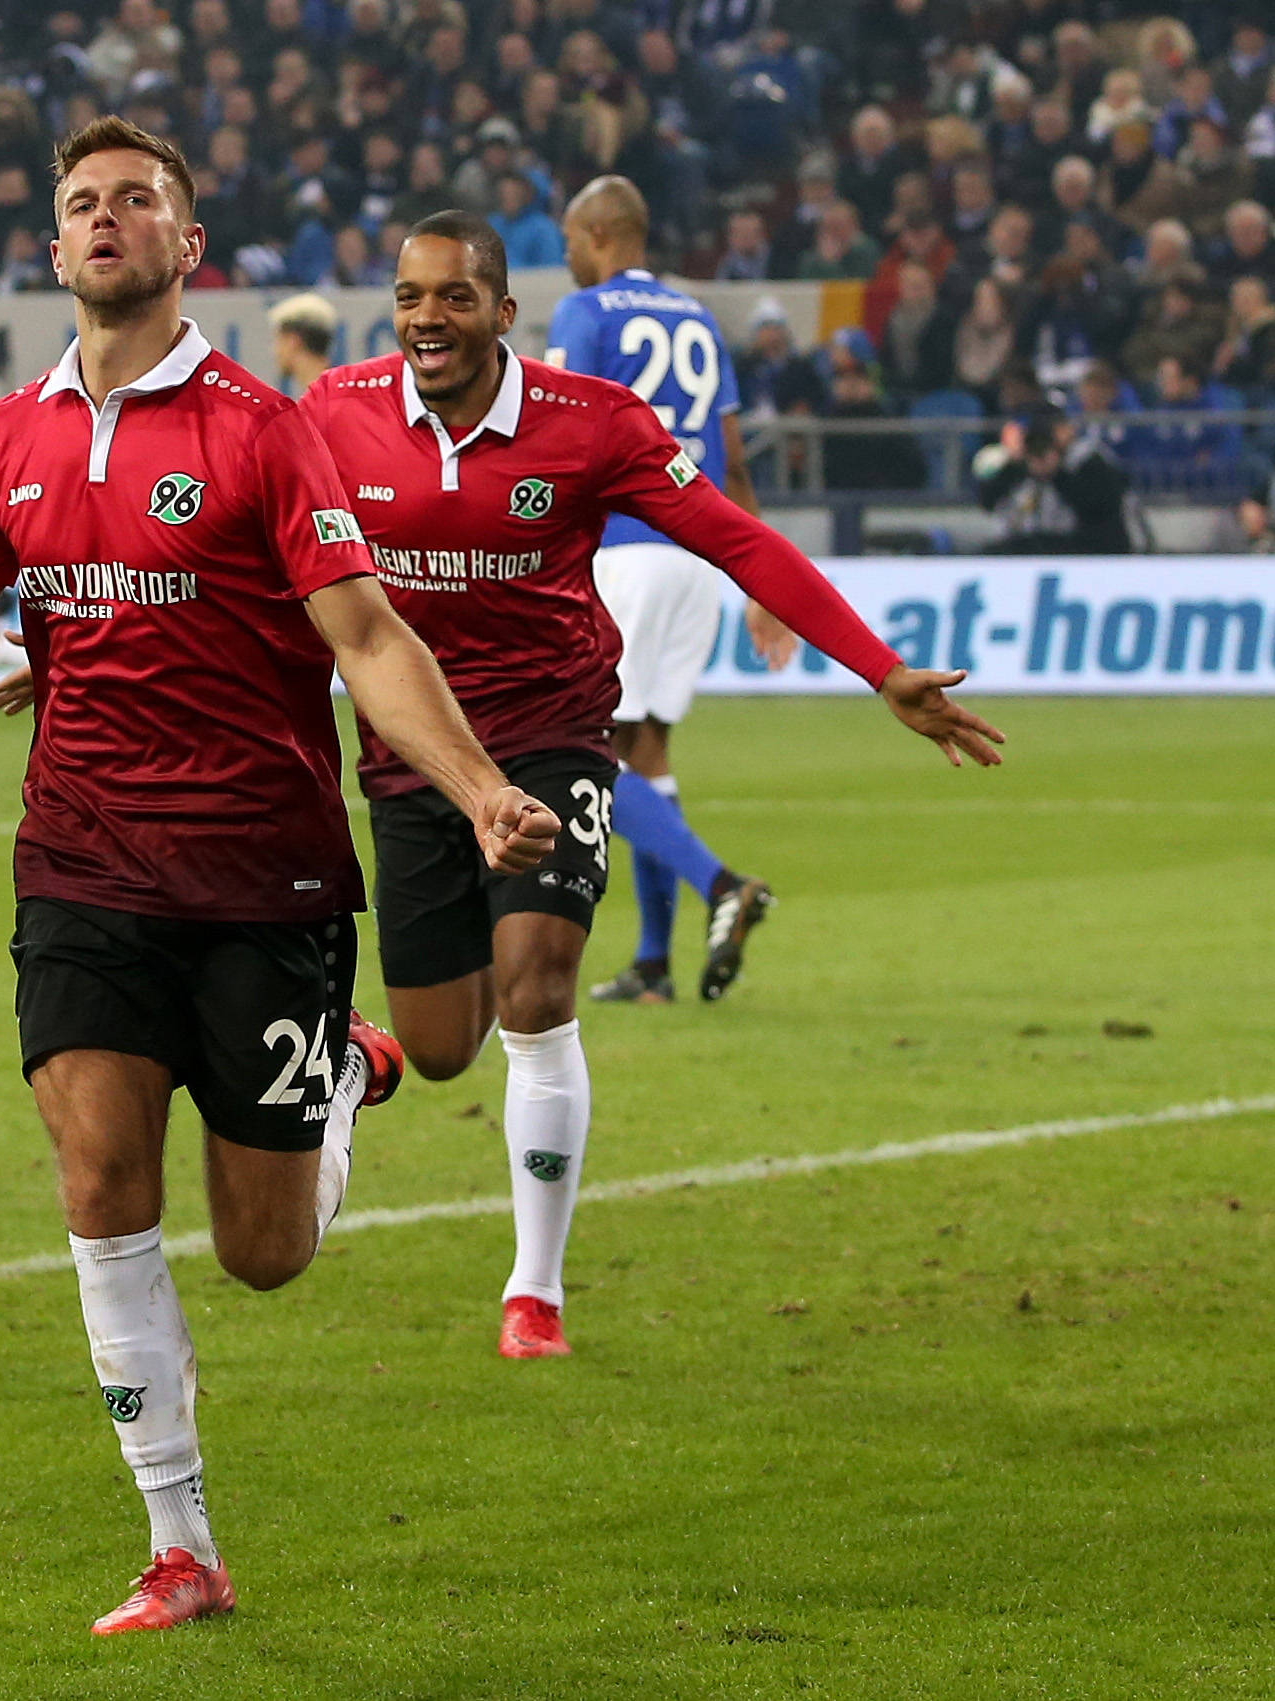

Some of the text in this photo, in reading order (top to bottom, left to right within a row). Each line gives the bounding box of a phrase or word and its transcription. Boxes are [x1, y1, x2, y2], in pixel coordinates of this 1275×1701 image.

[620, 316, 719, 430] 29
[8, 483, 44, 506] JAKO
[150, 478, 206, 520] 96
[357, 484, 395, 502] JAKO
[509, 481, 555, 517] 96
[367, 541, 542, 580] HEINZ VON HEIDEN
[71, 563, 115, 600] VON
[113, 561, 197, 605] HEIDEN
[257, 1012, 335, 1105] 24
